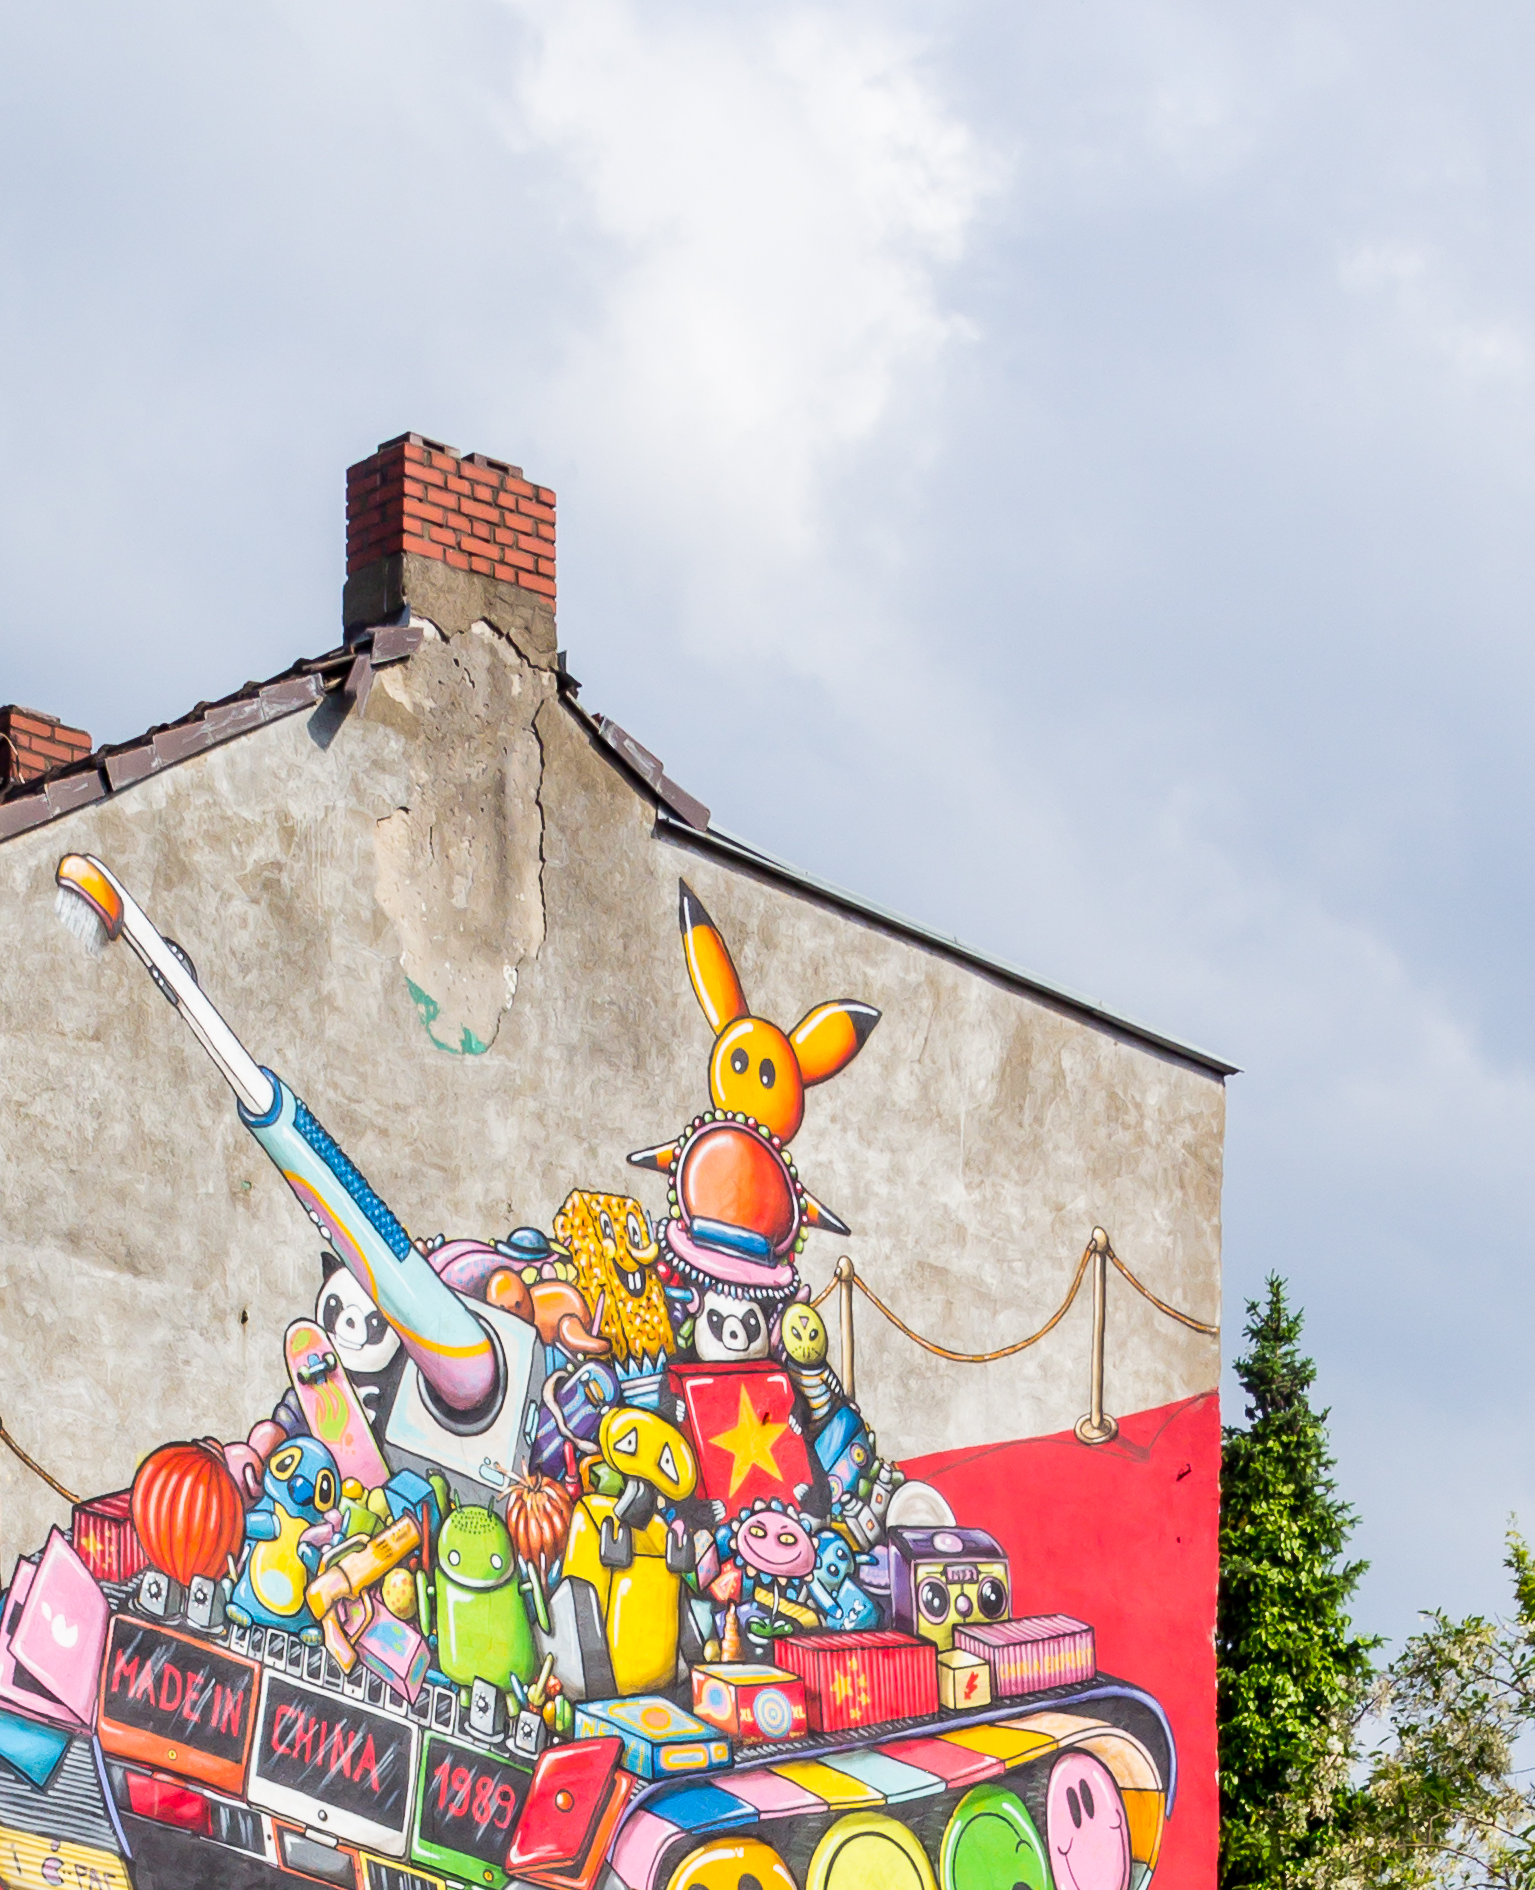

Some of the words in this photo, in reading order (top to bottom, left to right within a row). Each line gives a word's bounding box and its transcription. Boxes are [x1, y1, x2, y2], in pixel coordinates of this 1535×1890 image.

[111, 1648, 203, 1720] MADE
[210, 1686, 245, 1737] IN
[270, 1702, 380, 1791] CHINA
[433, 1761, 517, 1829] 1989
